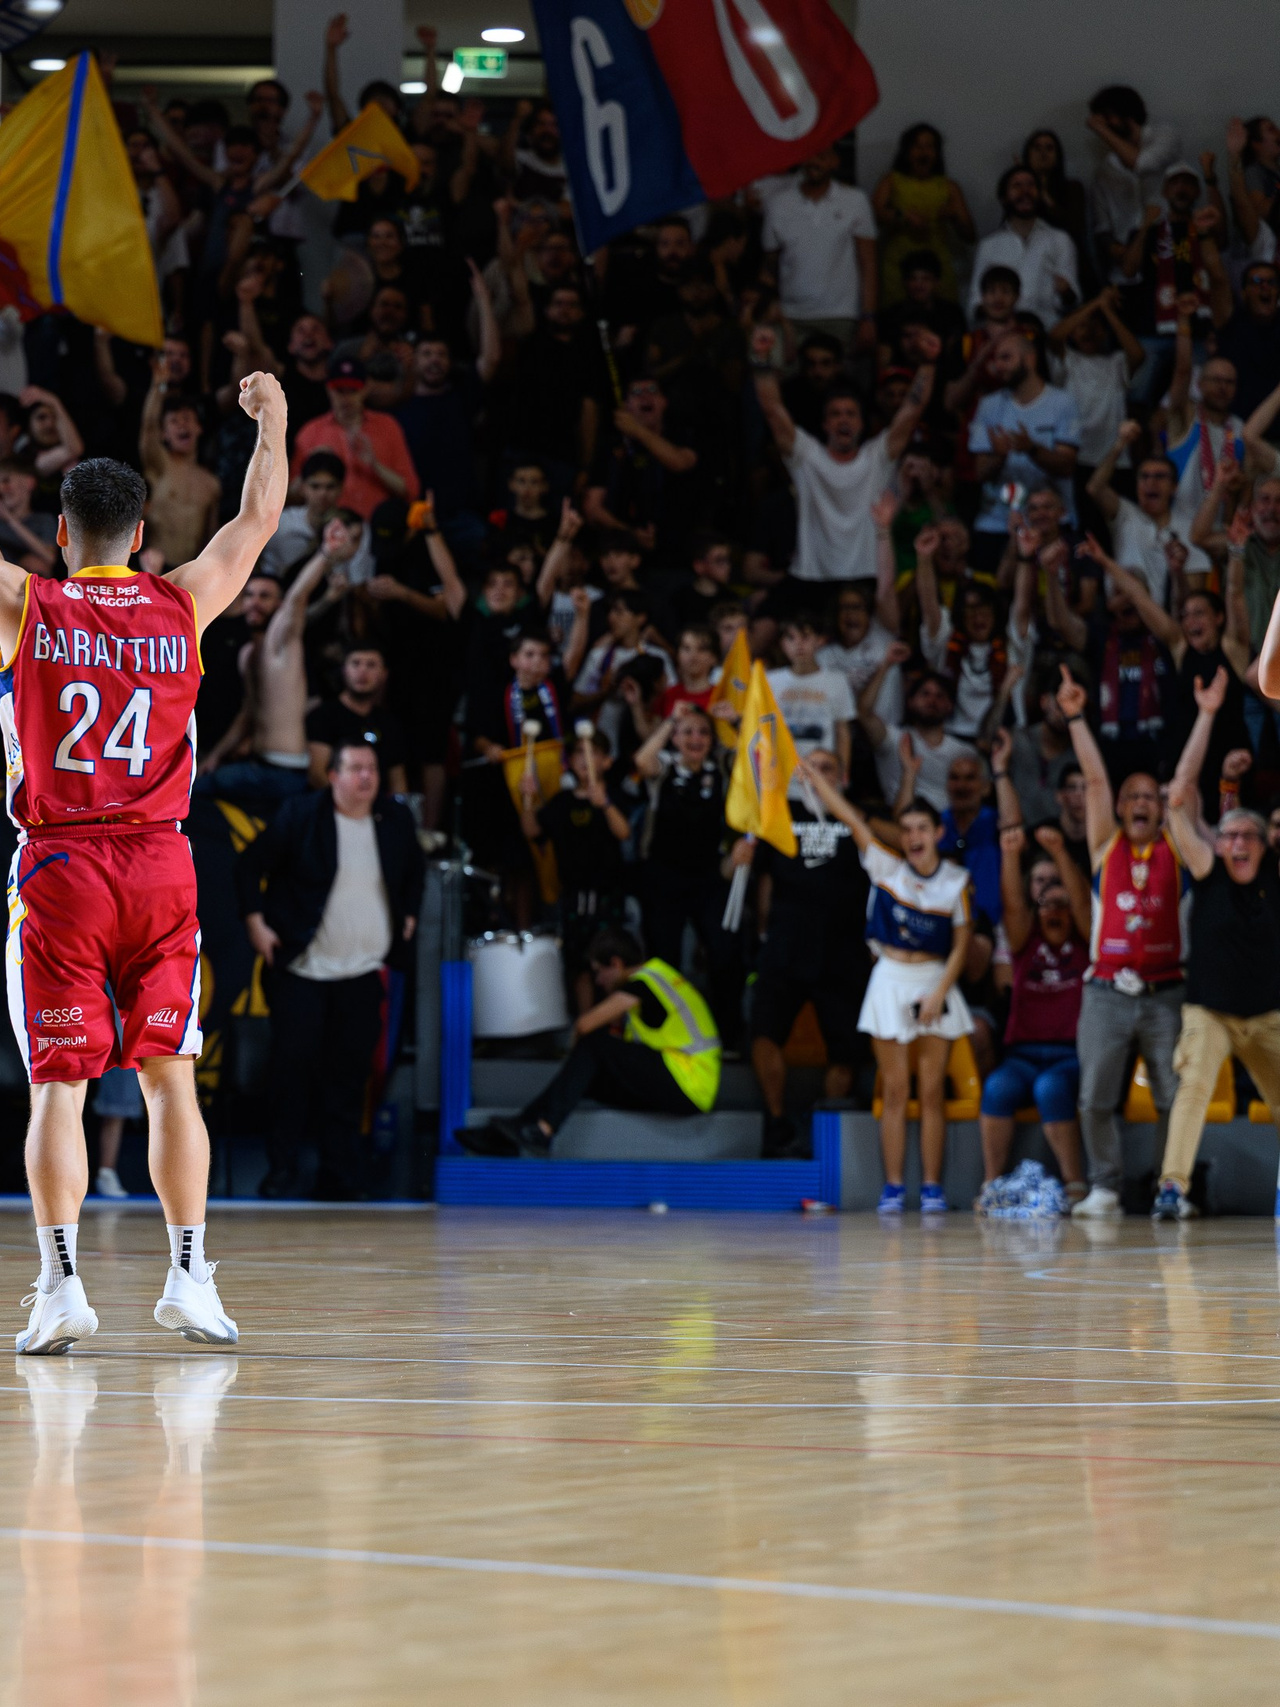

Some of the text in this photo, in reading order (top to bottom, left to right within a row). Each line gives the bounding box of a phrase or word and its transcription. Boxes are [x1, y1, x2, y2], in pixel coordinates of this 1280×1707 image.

[570, 16, 632, 218] 6
[86, 585, 140, 596] IDEE PER
[86, 594, 153, 608] VIAGGIARE
[33, 621, 188, 674] BARATTINI
[53, 680, 153, 778] 24
[33, 1006, 84, 1028] 4esse
[49, 1035, 87, 1046] FORUM
